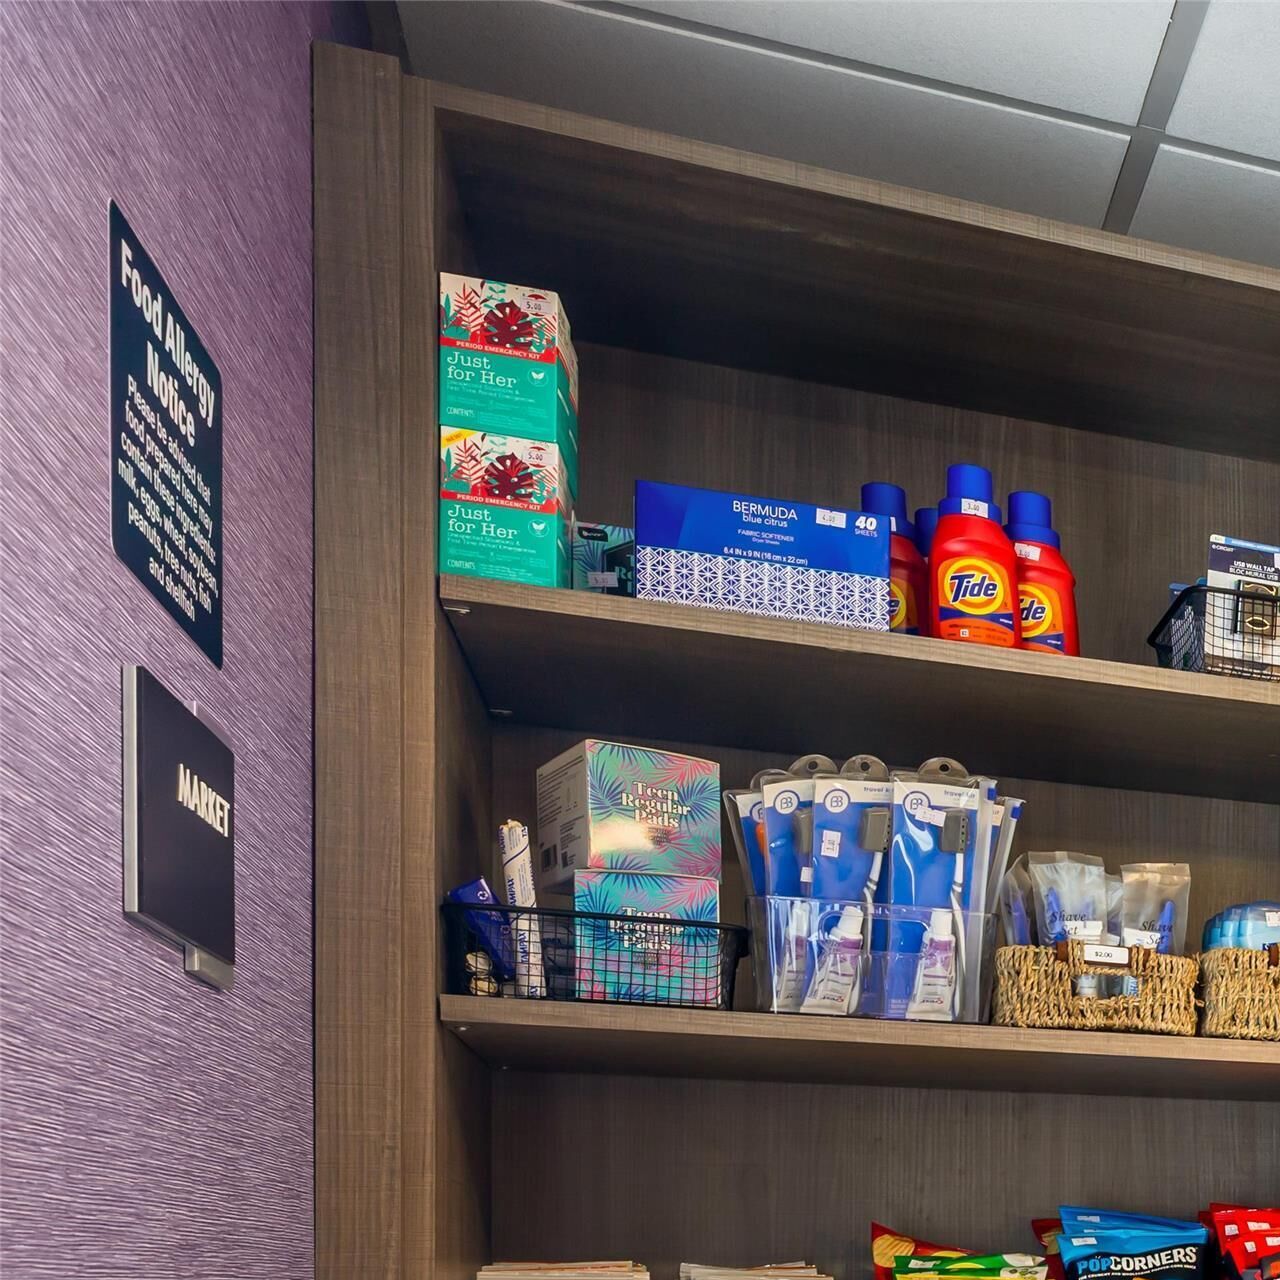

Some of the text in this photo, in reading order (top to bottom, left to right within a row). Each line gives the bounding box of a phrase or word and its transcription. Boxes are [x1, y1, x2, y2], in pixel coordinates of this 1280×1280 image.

[121, 238, 215, 427] Food Allergy
[456, 340, 483, 350] PERIOD
[484, 344, 528, 358] EMERGENCY
[446, 351, 491, 369] Just
[447, 366, 517, 388] for Her
[147, 340, 195, 447] Notice
[128, 374, 211, 506] Please be advised that
[125, 400, 213, 538] food prepared here may
[121, 432, 216, 566] contain these ingredients:
[456, 493, 541, 511] PERIOD EMERGENCY KIT
[447, 504, 492, 521] Just
[733, 500, 797, 521] BERMUDA
[118, 457, 219, 599] milk, eggs, wheat, soybean,
[447, 518, 517, 539] for Her
[742, 513, 788, 528] blue citrus
[855, 516, 877, 530] 40
[738, 529, 794, 542] FABRIC SOFTENER
[854, 529, 878, 538] SHEETS
[128, 500, 212, 615] peanuts, tree nuts, fish
[1234, 560, 1276, 573] USB WALL TAP
[1229, 567, 1244, 576] BLOC
[1266, 573, 1278, 581] USB
[149, 555, 195, 622] and shellfish
[950, 573, 997, 603] Tide
[177, 762, 230, 838] MARKET
[633, 781, 678, 800] Teen
[621, 793, 691, 816] Regular
[634, 809, 680, 828] Pads
[1051, 909, 1086, 923] Shave
[609, 918, 684, 938] Regular
[1062, 924, 1078, 935] Set
[1141, 919, 1173, 934] Shave
[624, 934, 671, 950] Pads
[1146, 933, 1165, 945] Set
[1094, 951, 1113, 959] $2.00
